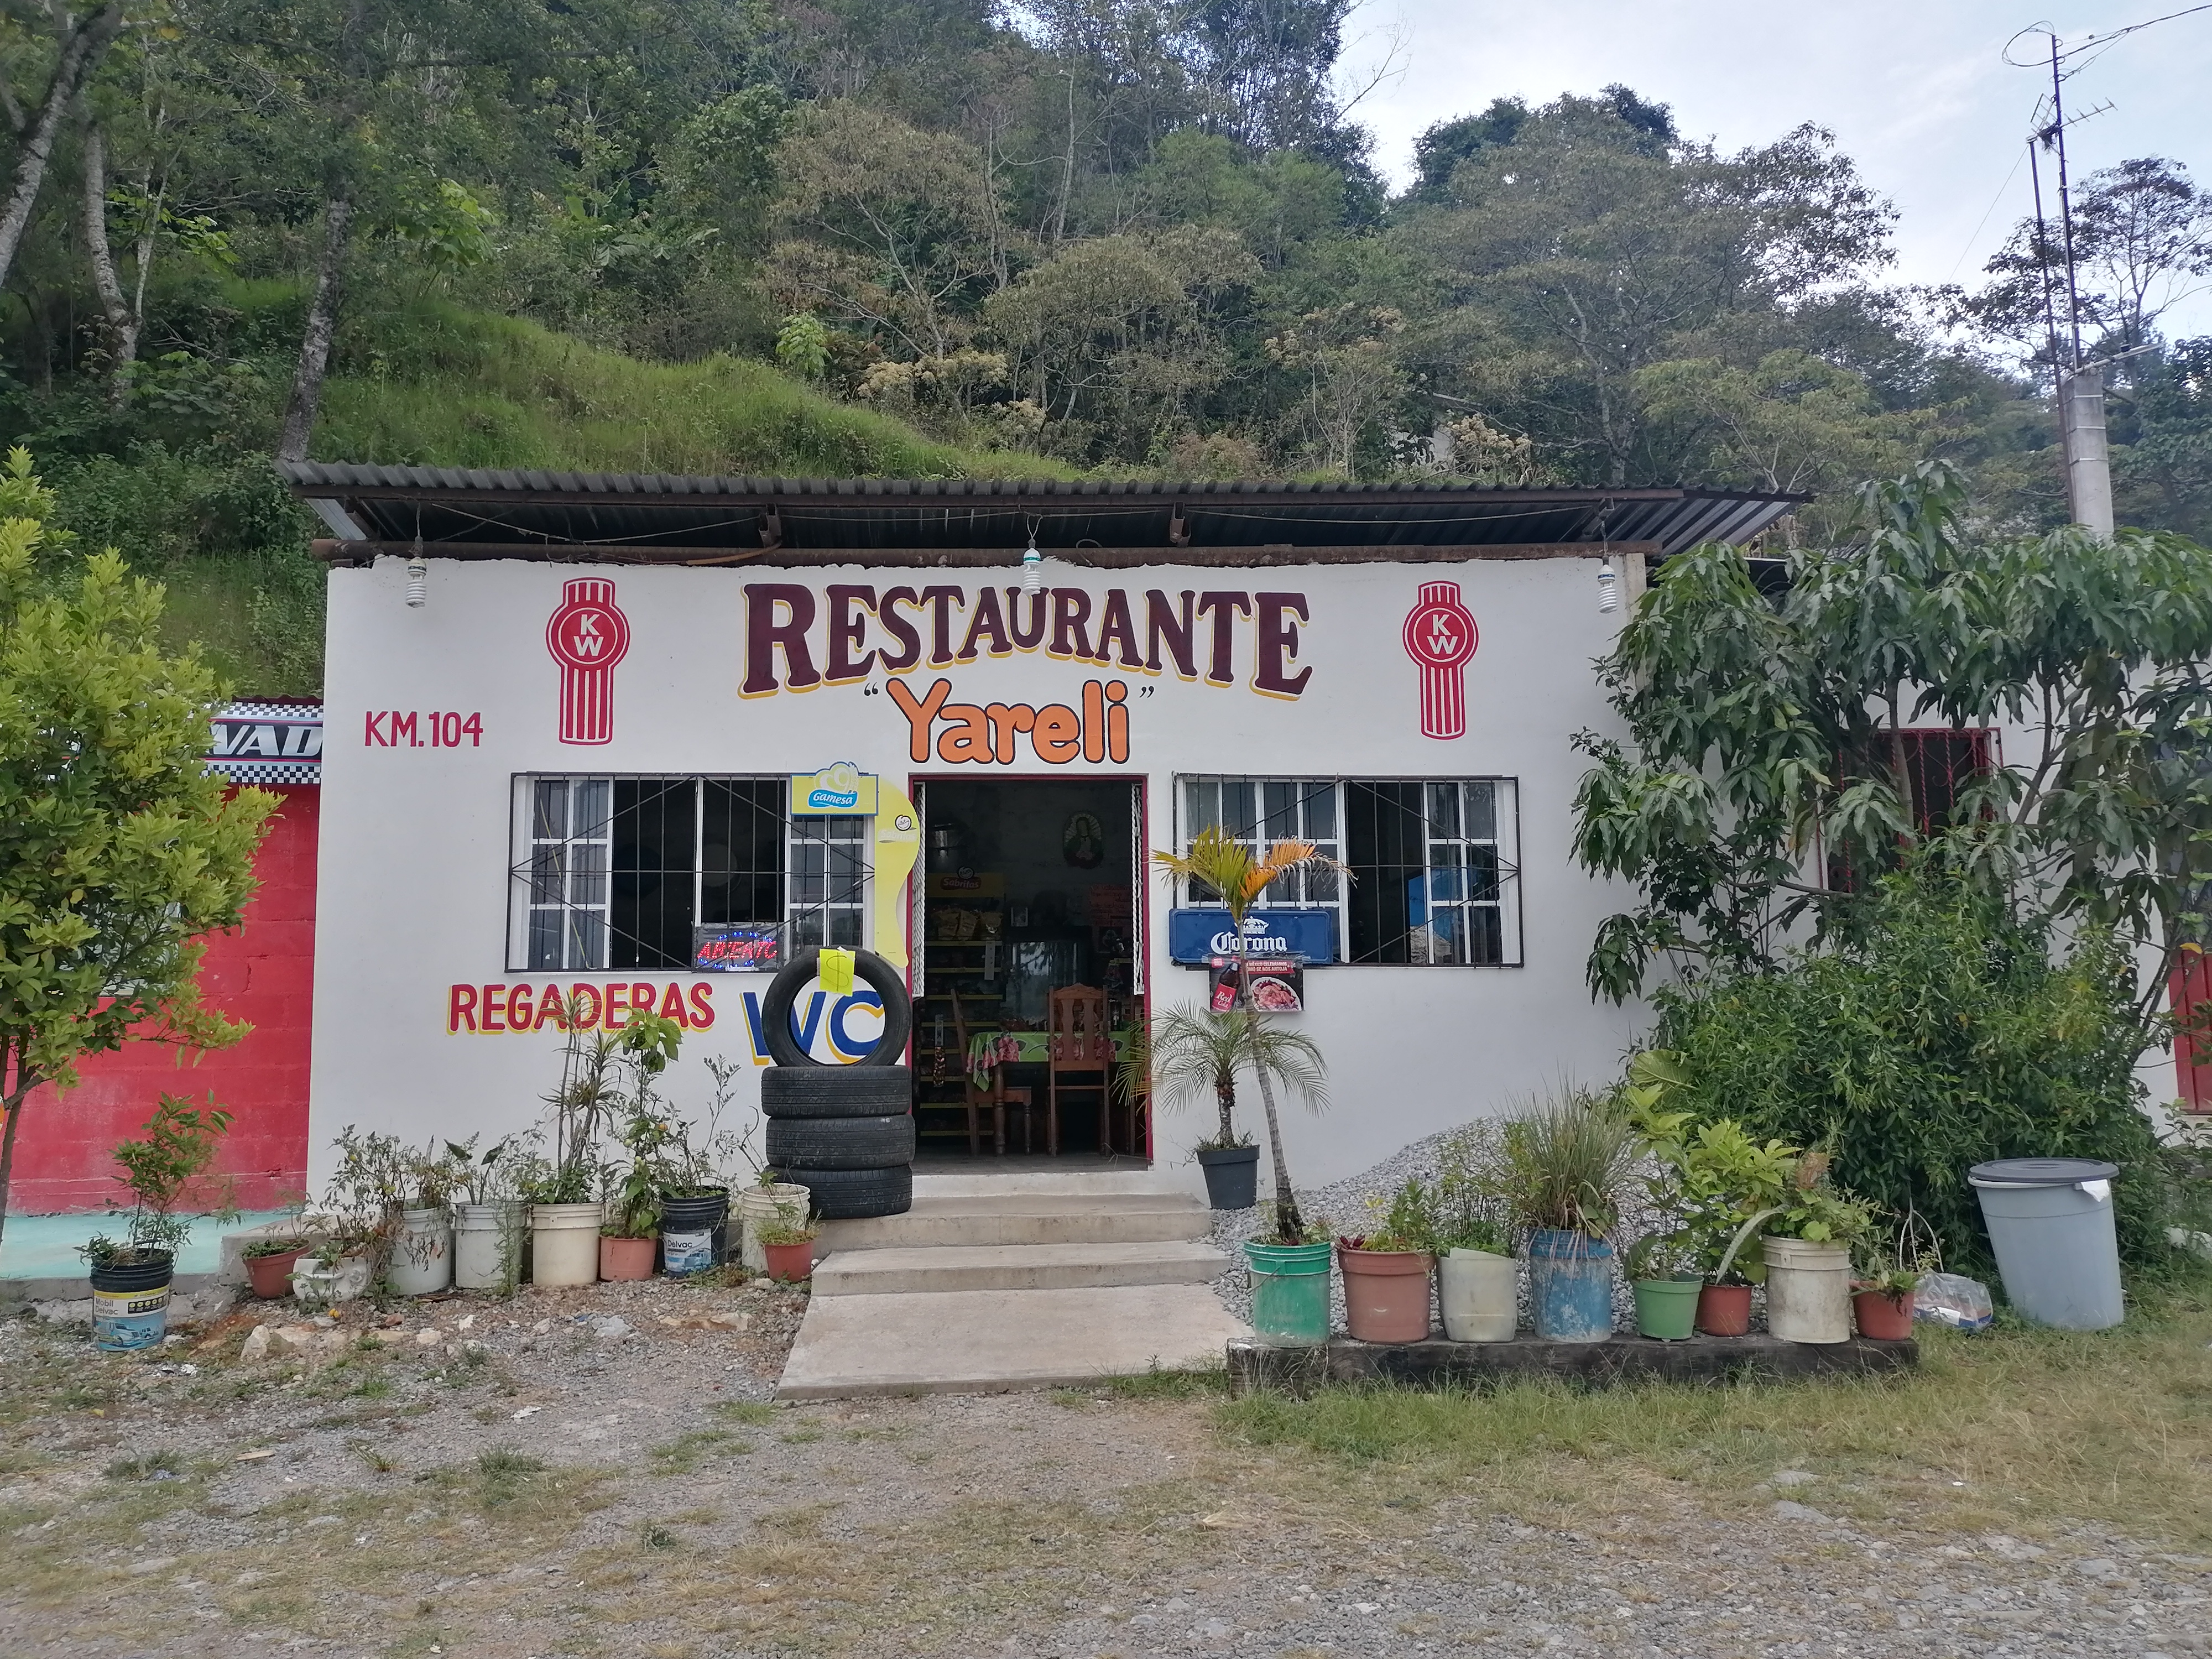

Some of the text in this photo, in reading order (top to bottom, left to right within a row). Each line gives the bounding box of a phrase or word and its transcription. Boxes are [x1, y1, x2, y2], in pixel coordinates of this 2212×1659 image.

[738, 583, 1313, 701] RESTAURANTE
[364, 711, 484, 748] KM.104
[813, 791, 853, 805] Gamesa
[942, 878, 979, 888] Sabritas
[1210, 931, 1288, 954] Corona
[1216, 991, 1233, 1003] Red
[446, 981, 716, 1035] REGADERAS
[739, 990, 885, 1066] WC
[667, 1239, 693, 1248] Delvac
[95, 1297, 114, 1307] Mobil
[95, 1305, 118, 1315] Delvac
